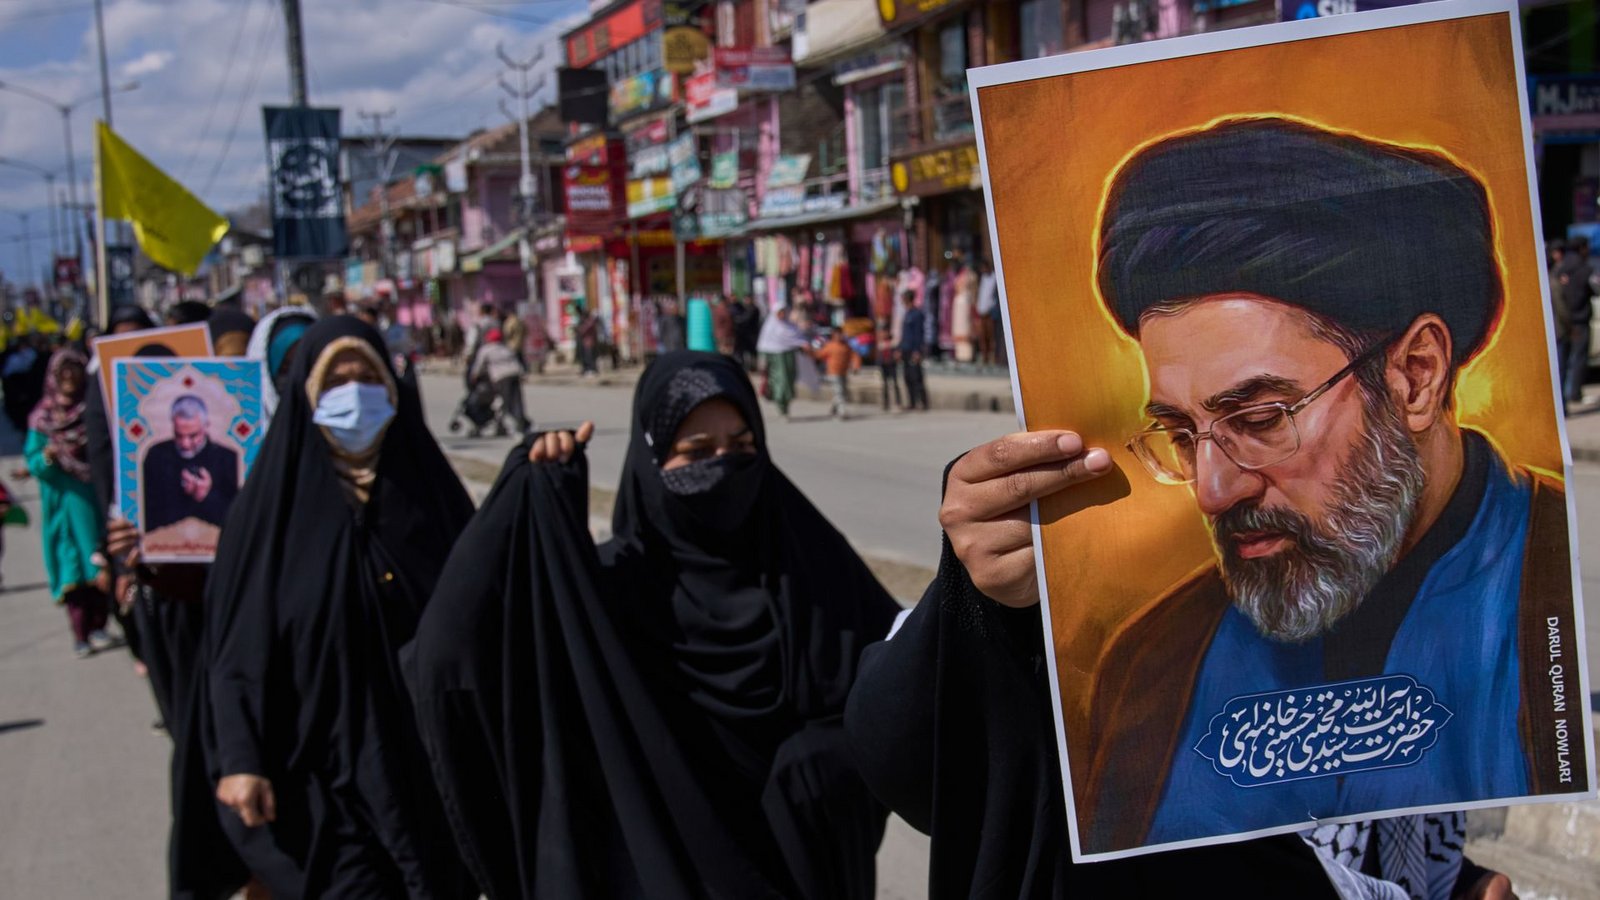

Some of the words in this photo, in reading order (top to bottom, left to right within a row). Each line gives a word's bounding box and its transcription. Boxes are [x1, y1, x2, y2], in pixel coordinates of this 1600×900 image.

[1546, 616, 1562, 662] DARUL
[1548, 664, 1566, 712] QURAN
[1555, 719, 1572, 783] NOWLARI
